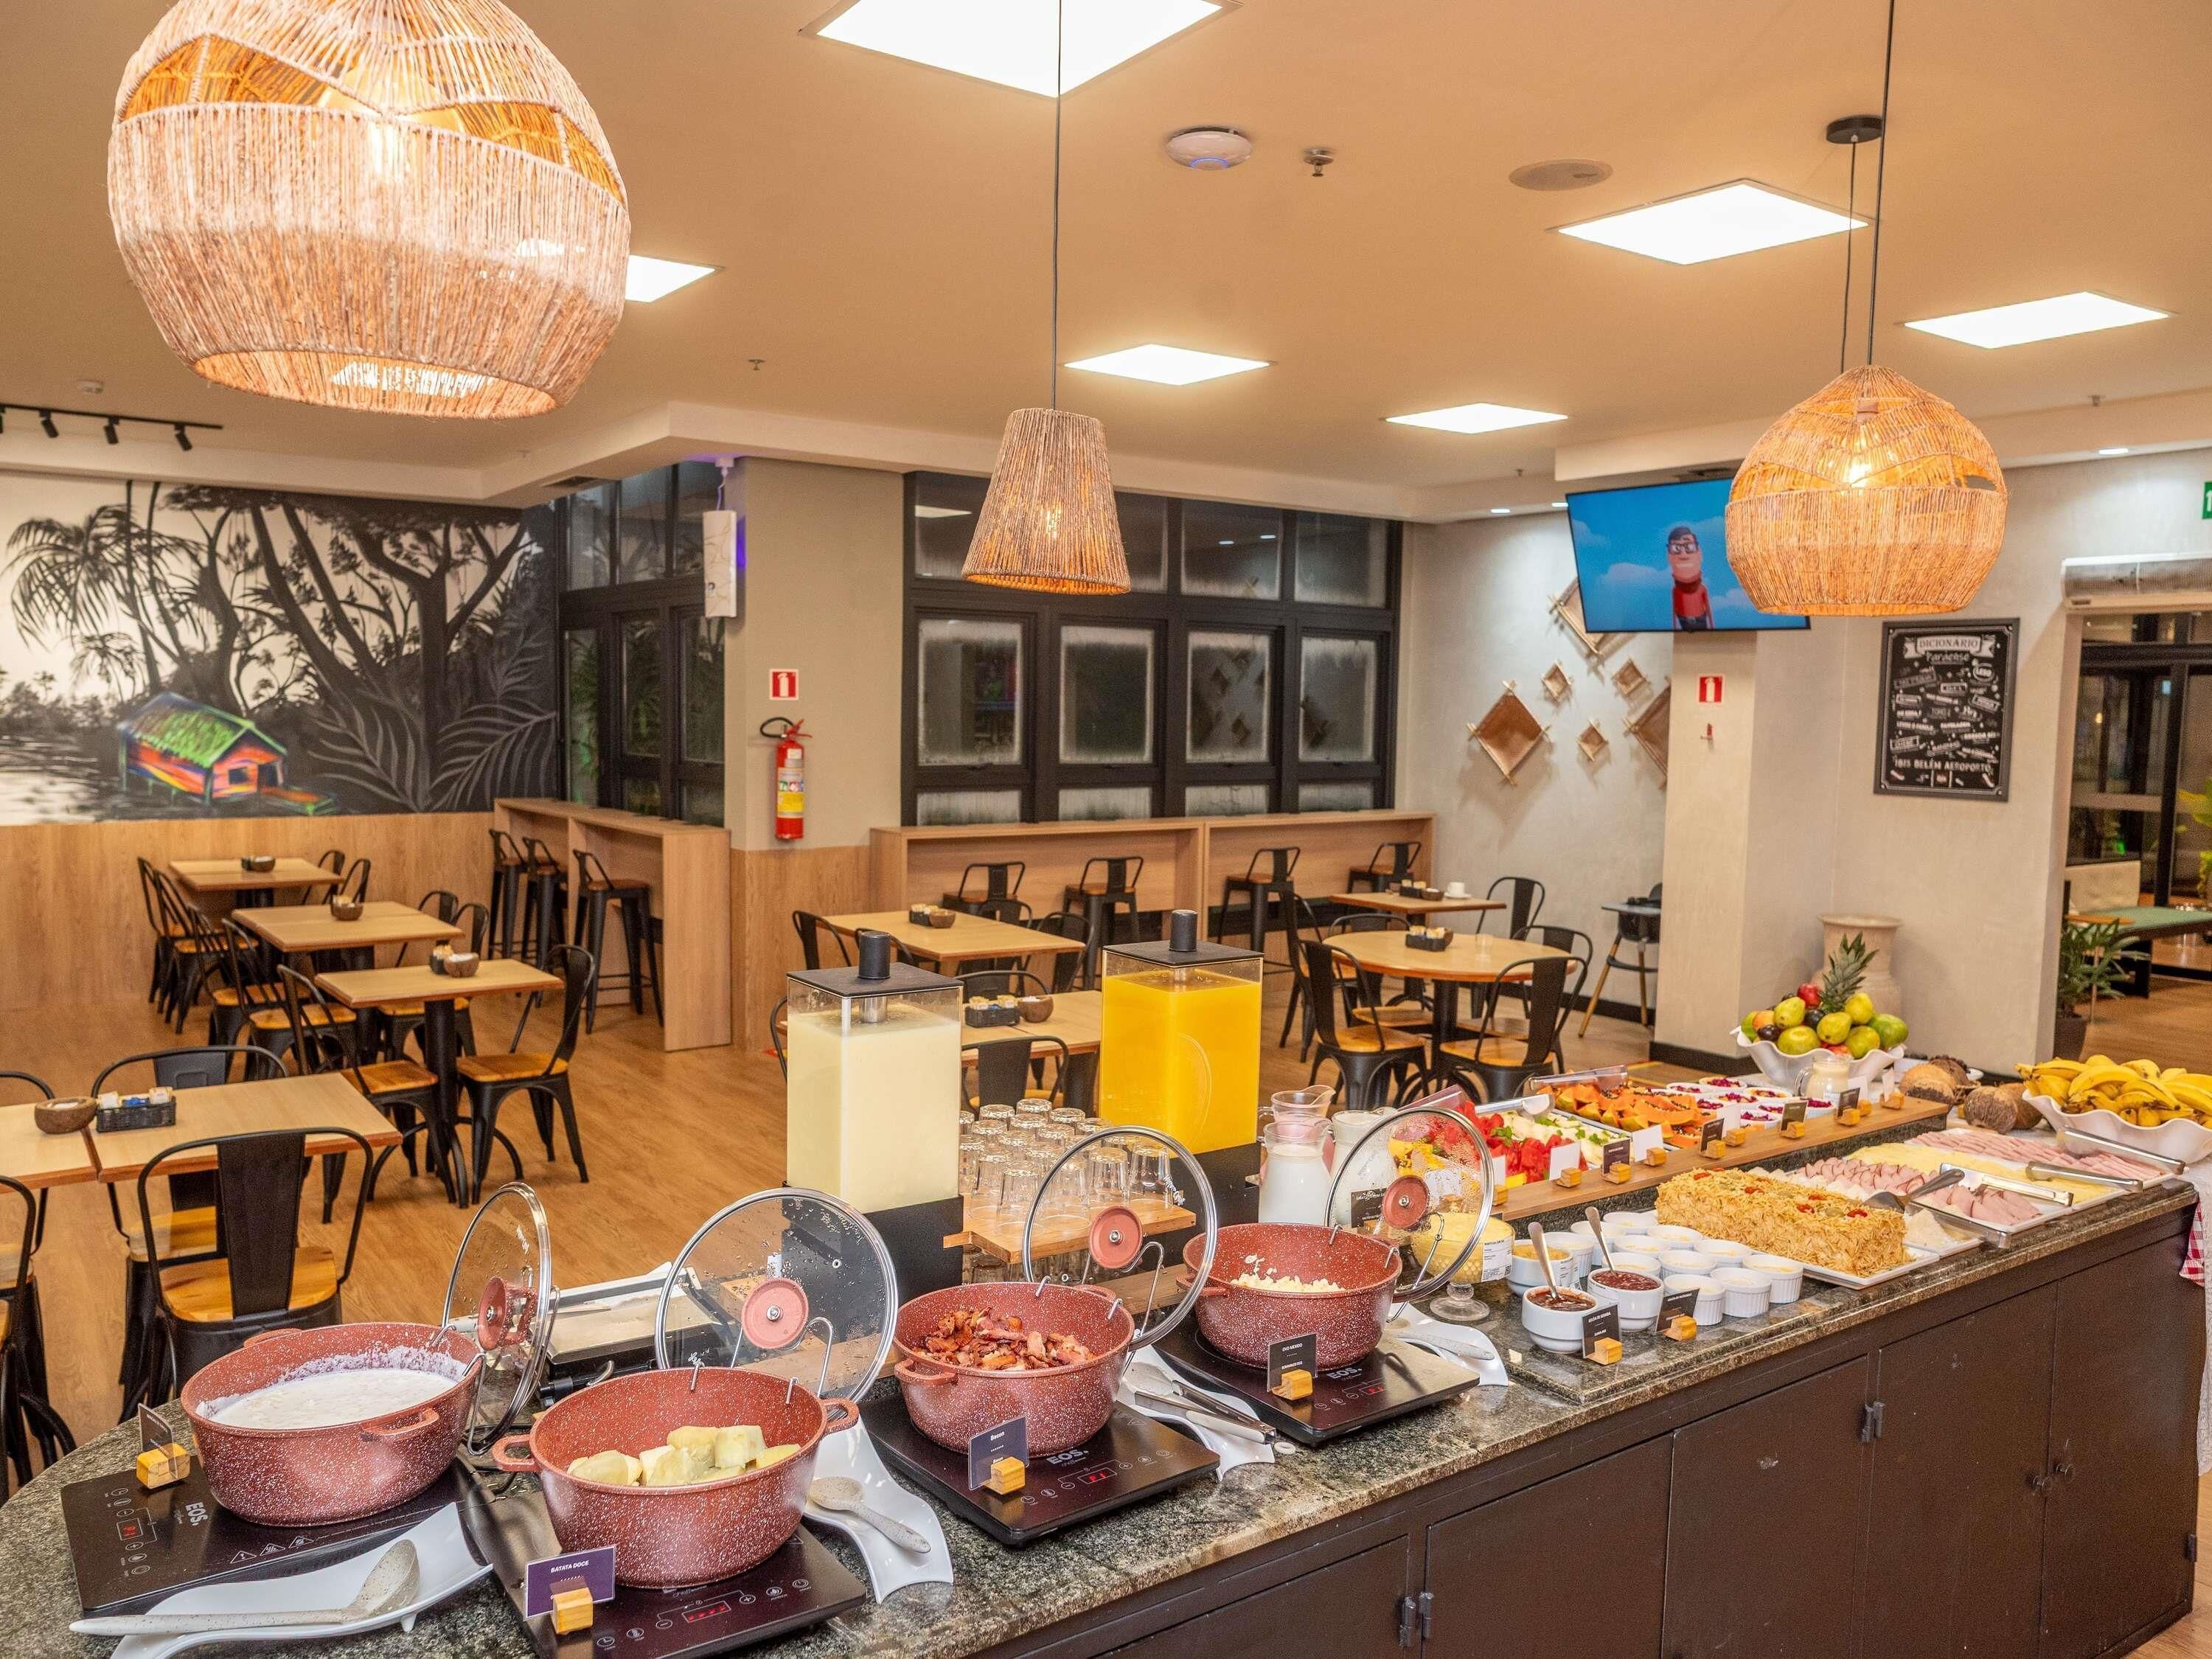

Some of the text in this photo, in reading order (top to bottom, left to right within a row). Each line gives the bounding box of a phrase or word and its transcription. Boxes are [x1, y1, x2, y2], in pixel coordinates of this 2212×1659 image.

[990, 1431, 1005, 1441] Bacon
[551, 1559, 590, 1573] BATATA DOCE
